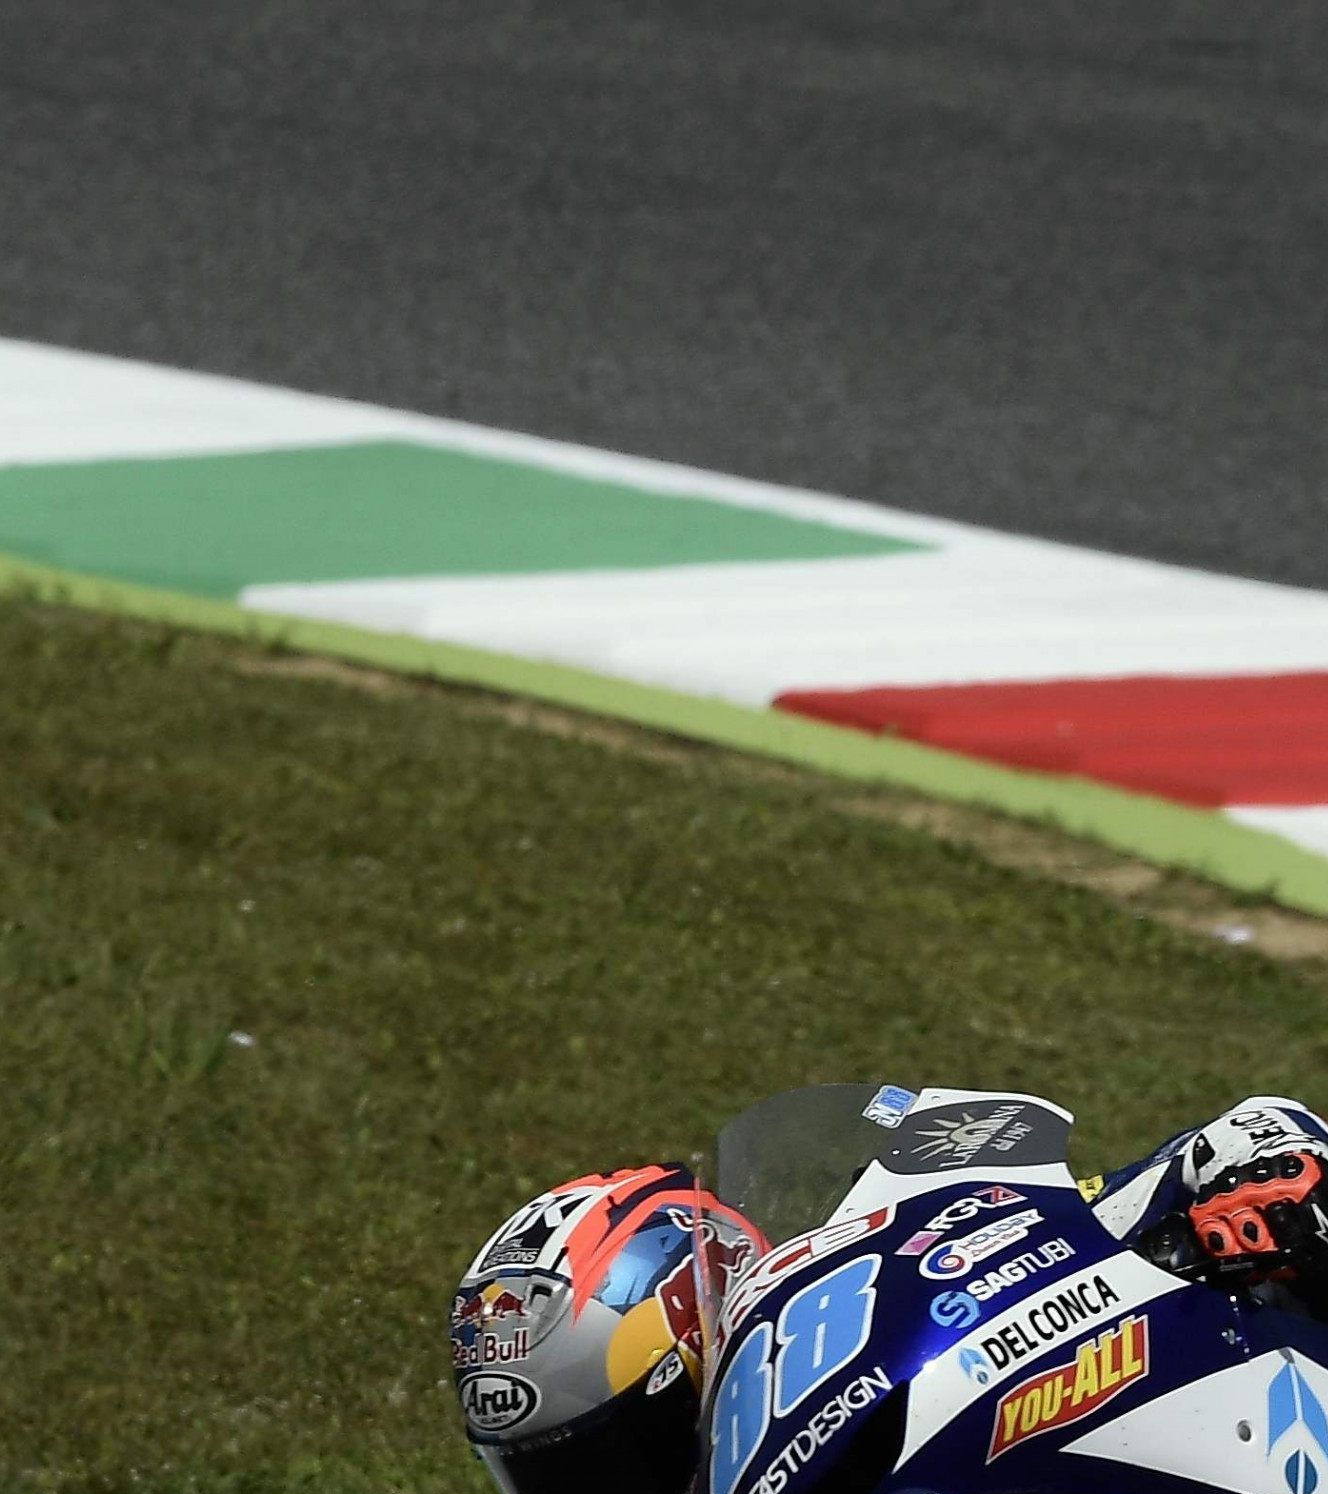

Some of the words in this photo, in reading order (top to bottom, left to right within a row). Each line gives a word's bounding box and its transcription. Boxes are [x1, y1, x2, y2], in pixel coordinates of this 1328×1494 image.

[966, 1237, 1076, 1302] SAGTUBI
[483, 1326, 531, 1366] Bull
[467, 1381, 523, 1417] Arai
[1002, 1318, 1143, 1443] YOU-ALL
